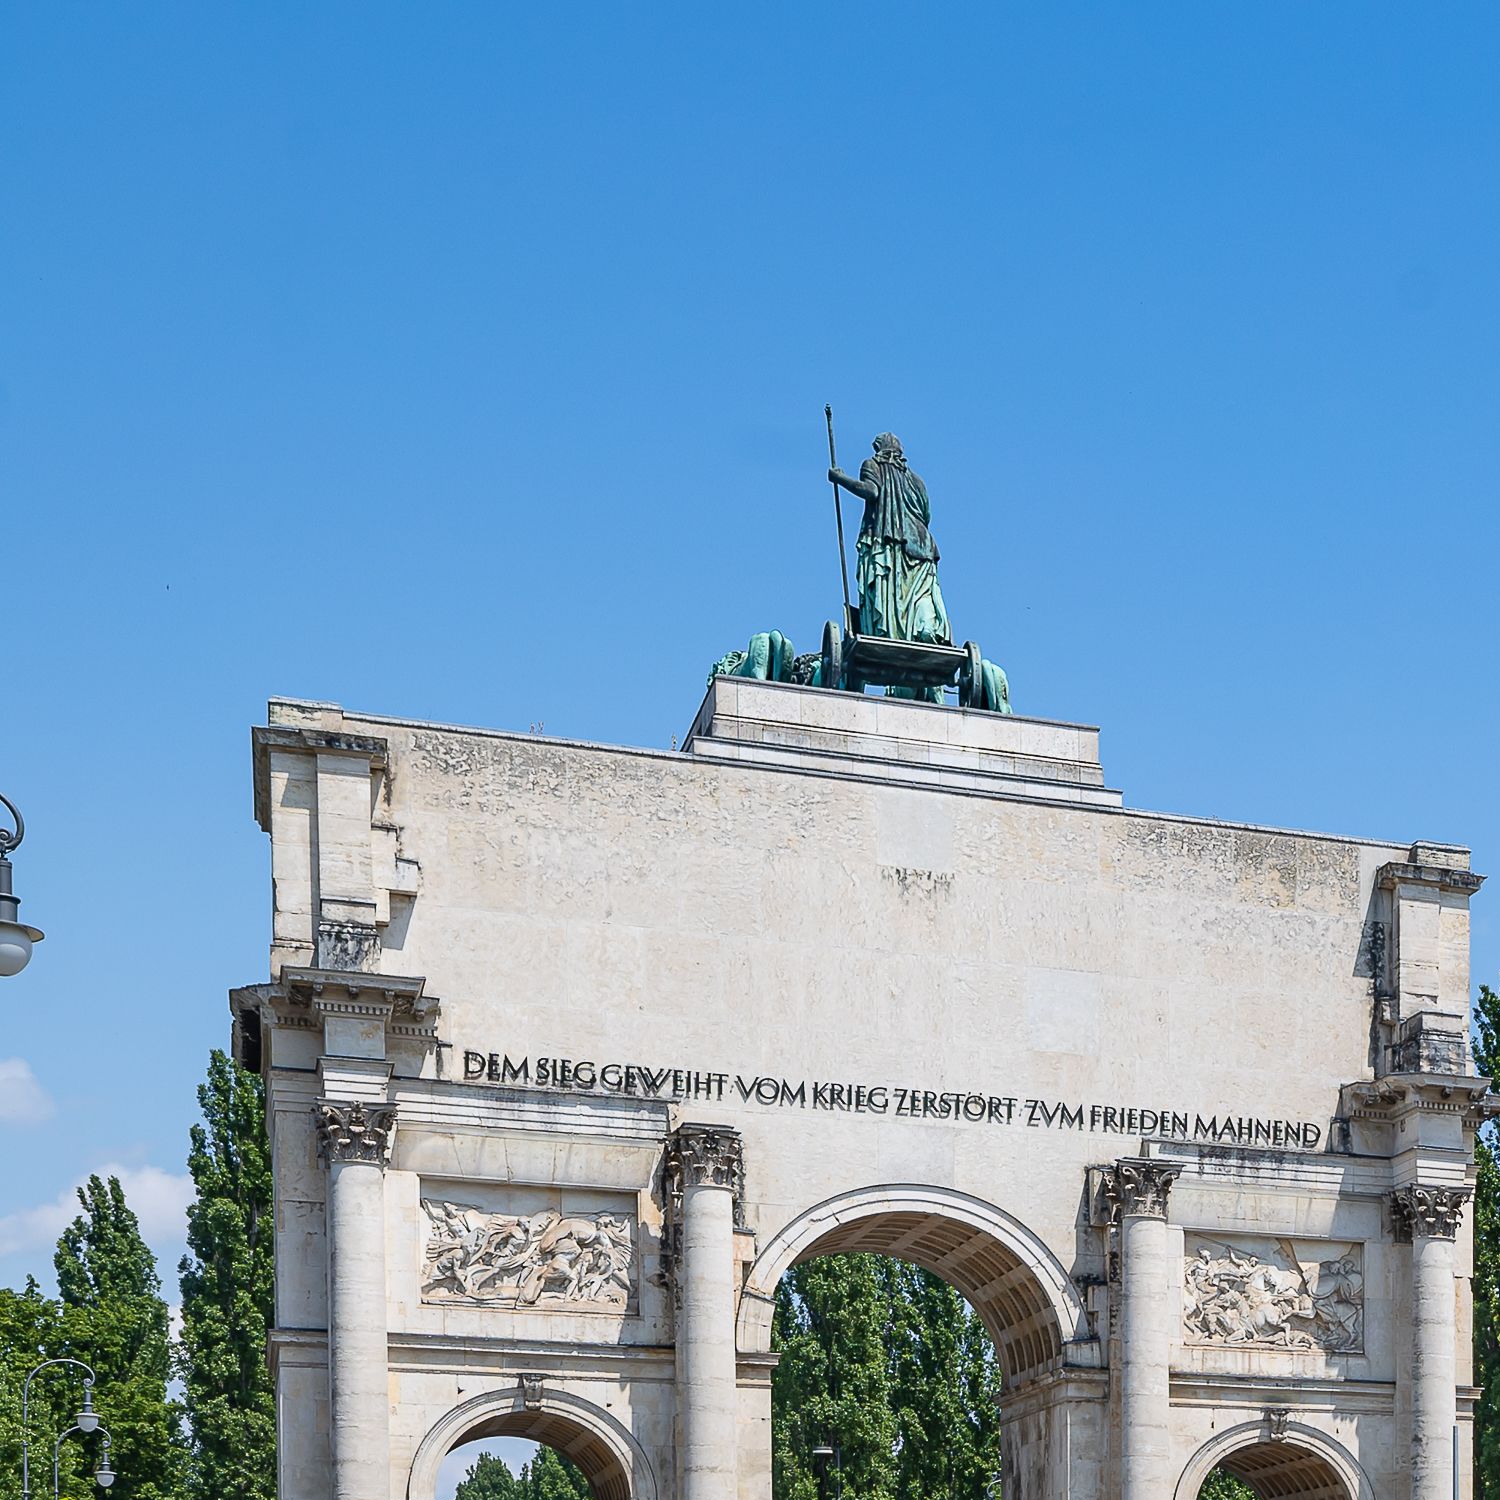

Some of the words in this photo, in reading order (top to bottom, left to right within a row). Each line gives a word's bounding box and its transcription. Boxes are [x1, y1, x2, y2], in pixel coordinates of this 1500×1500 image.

[463, 1051, 528, 1080] DEM
[537, 1056, 596, 1085] SIEG
[601, 1063, 728, 1096] GEWEIHT
[736, 1074, 805, 1103] VOM
[813, 1081, 889, 1110] KRIEG
[897, 1088, 1018, 1120] ZERSTÖRT
[1025, 1099, 1084, 1129] ZVM
[1090, 1106, 1188, 1135] FRIEDEN
[1195, 1114, 1321, 1146] MAHNEND
